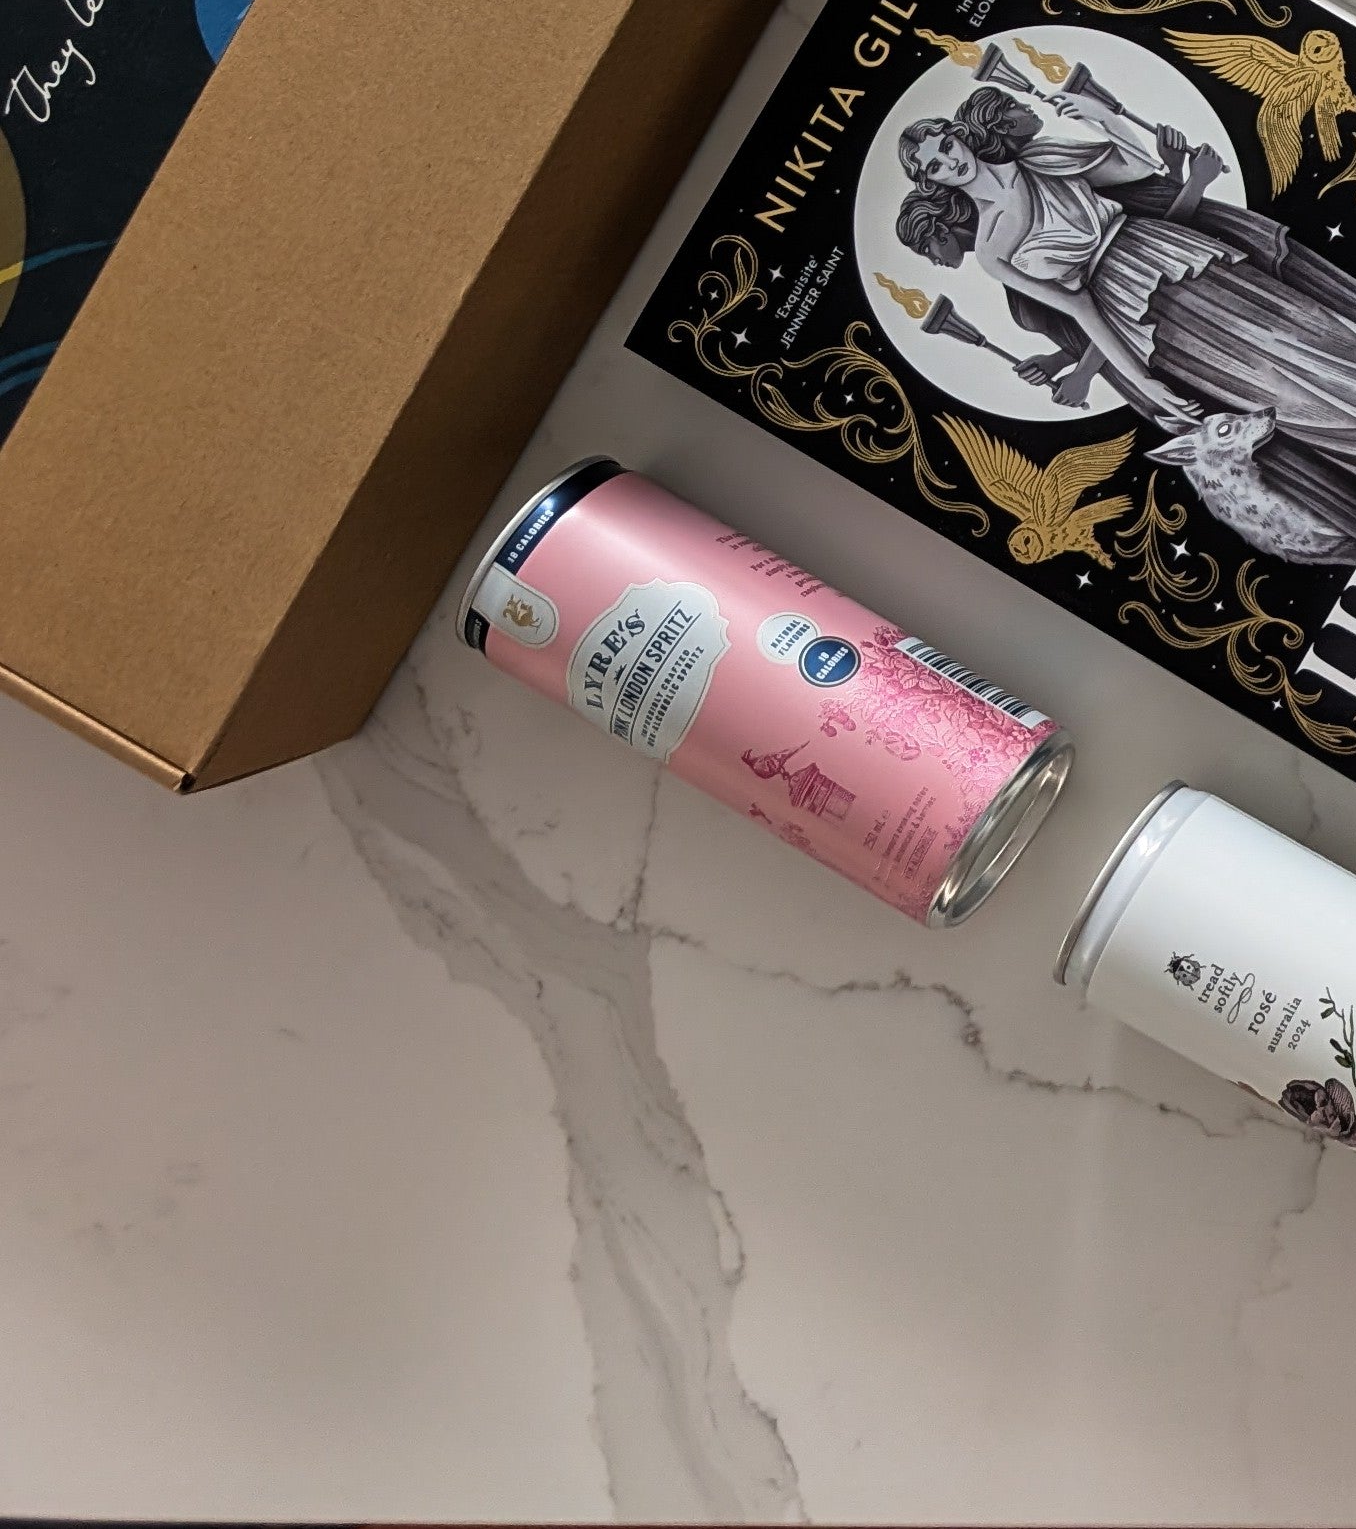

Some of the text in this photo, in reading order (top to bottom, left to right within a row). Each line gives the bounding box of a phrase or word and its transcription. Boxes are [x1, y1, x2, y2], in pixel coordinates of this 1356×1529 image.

[4, 38, 97, 123] They
[753, 86, 866, 233] NIKITA
[777, 244, 846, 350] JENNIFER SAINT
[515, 507, 554, 551] CALORIES
[770, 618, 801, 648] NATURAL
[777, 622, 812, 655] FLAVOURS
[583, 607, 648, 711] LYRE'S
[616, 660, 656, 717] LONDON
[644, 605, 694, 663] SPRITZ
[816, 644, 850, 679] CALORIES
[1197, 963, 1225, 1004] tread
[1213, 972, 1242, 1014] softly
[1247, 989, 1277, 1036] rosé
[1267, 997, 1302, 1054] australia
[1287, 1019, 1312, 1051] 2024
